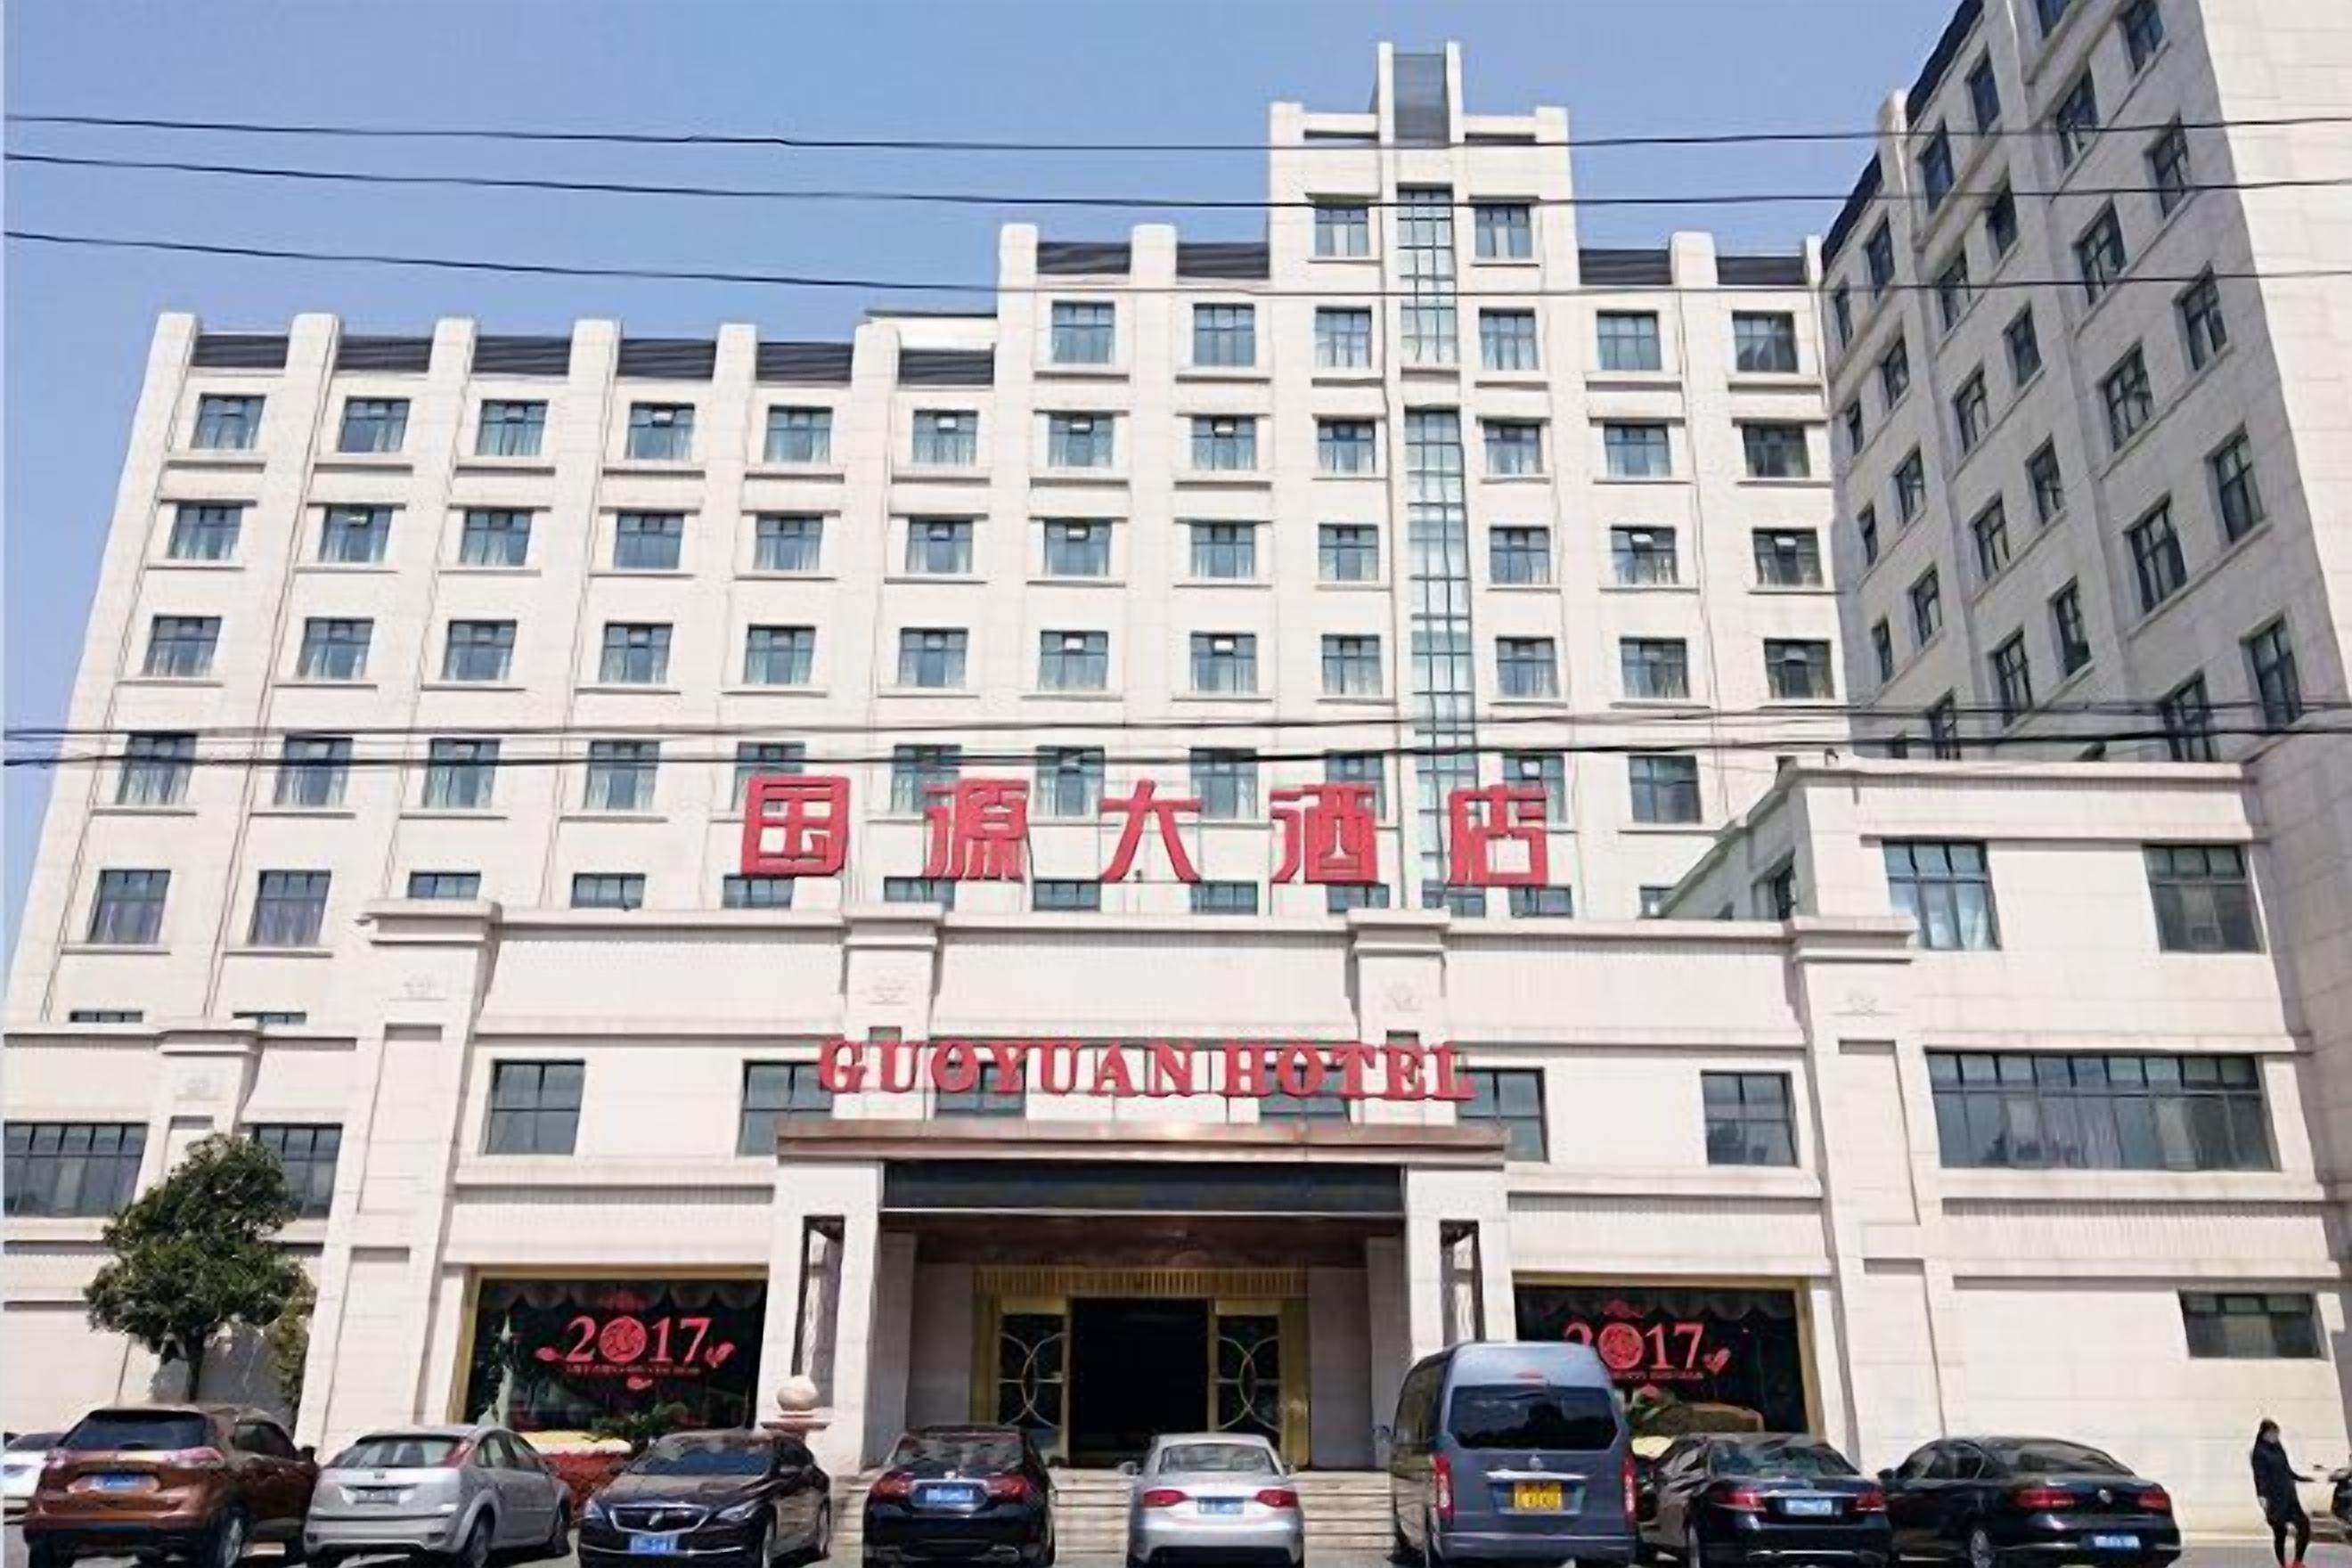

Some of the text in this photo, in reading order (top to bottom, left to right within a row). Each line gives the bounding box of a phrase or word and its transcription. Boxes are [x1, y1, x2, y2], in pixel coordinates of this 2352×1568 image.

[739, 773, 1551, 888] 国源大酒店
[565, 1315, 712, 1366] 2017
